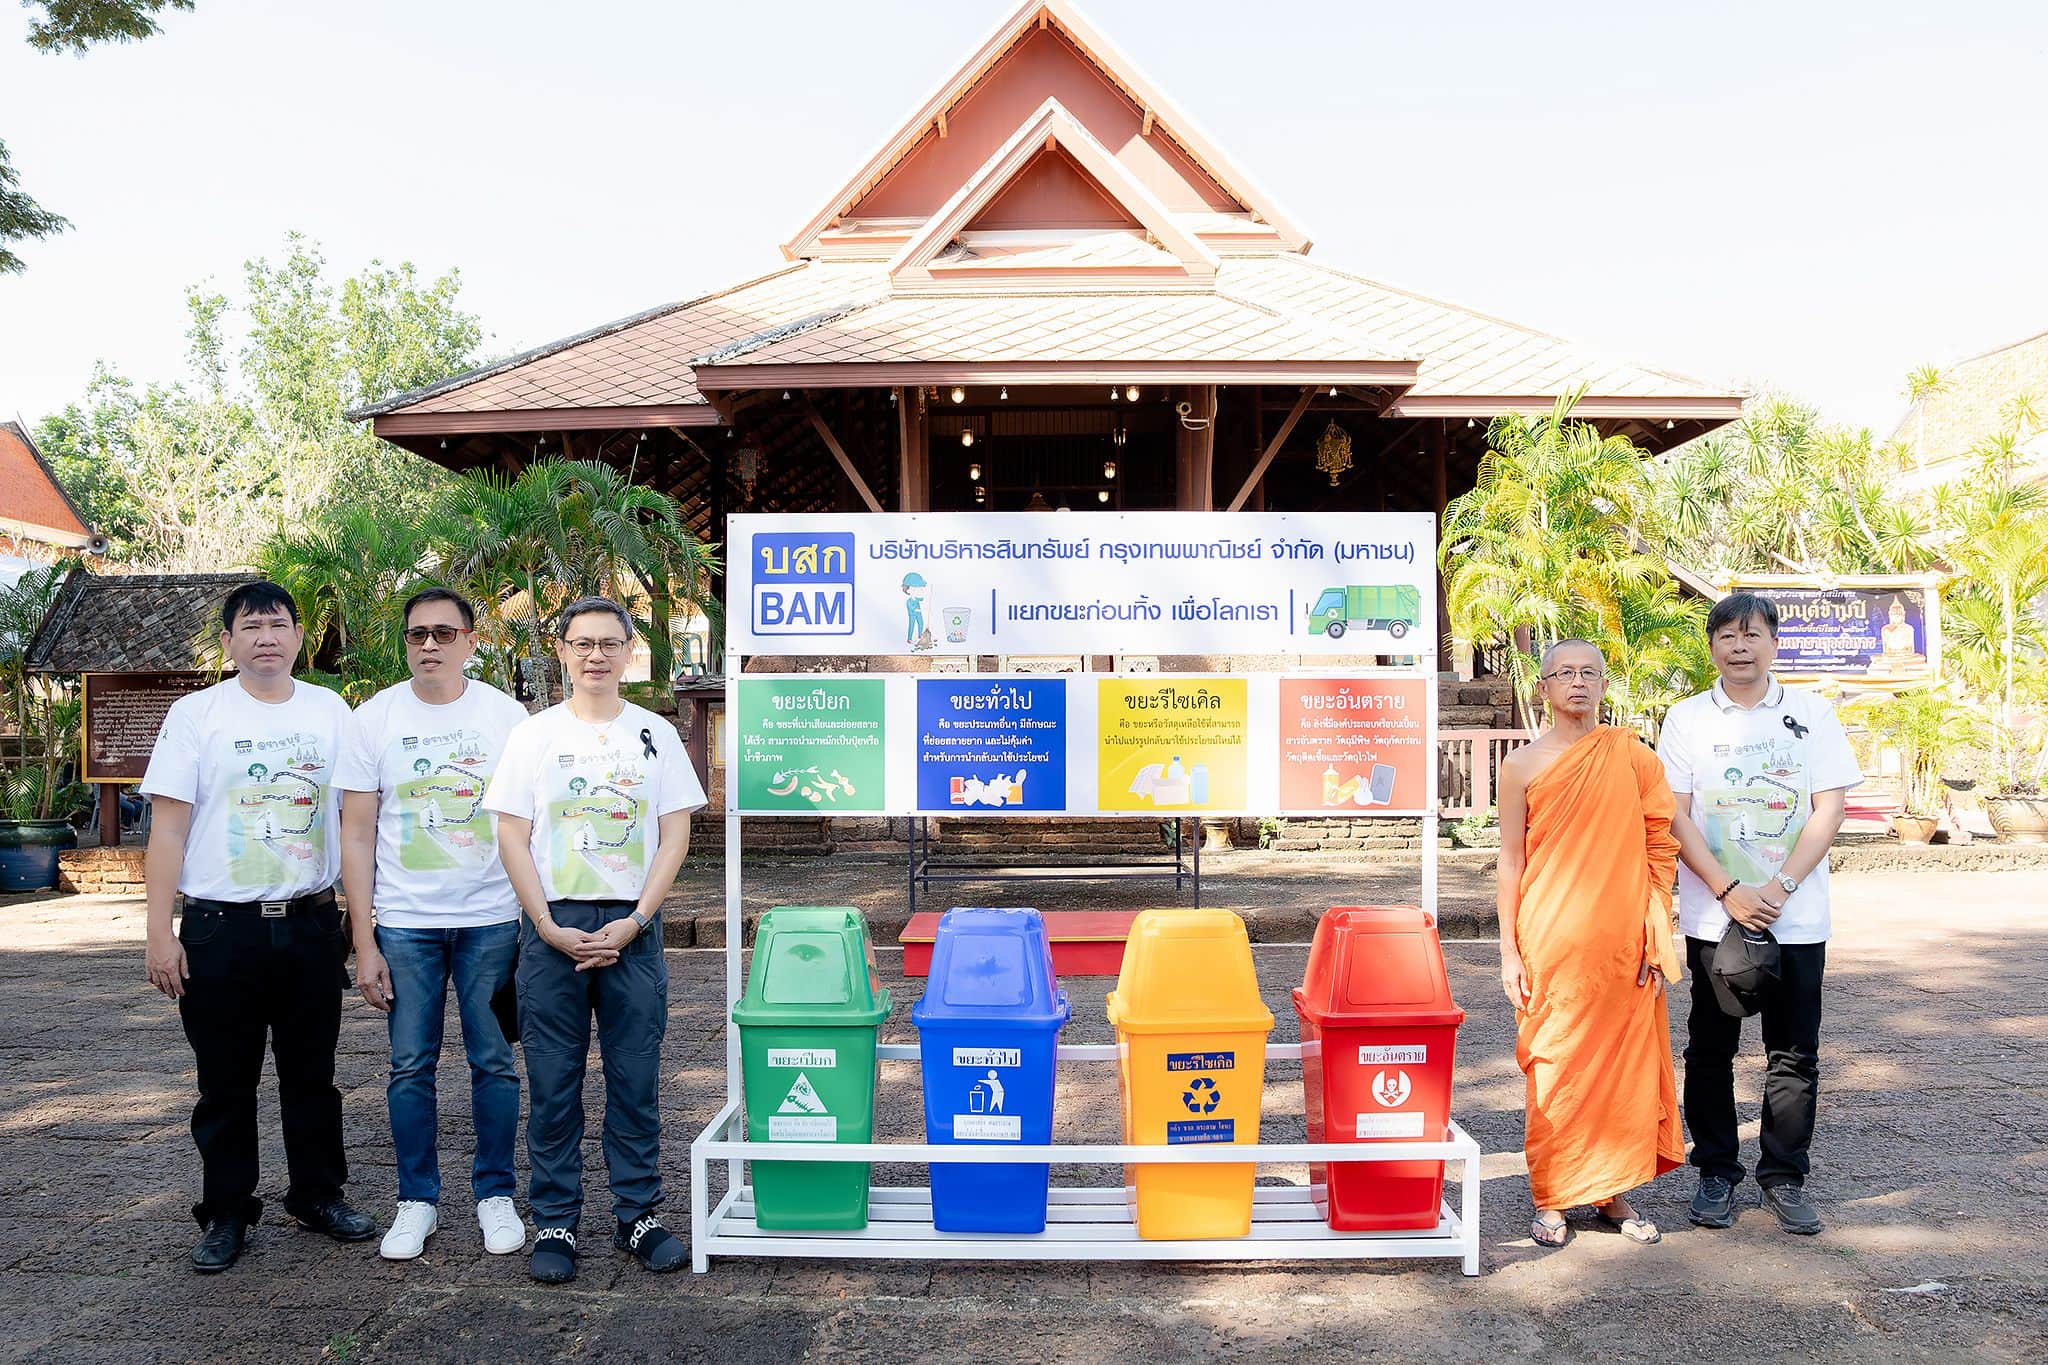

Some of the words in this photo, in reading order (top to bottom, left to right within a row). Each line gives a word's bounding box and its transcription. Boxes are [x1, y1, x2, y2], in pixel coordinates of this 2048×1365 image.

[760, 544, 847, 575] บสก
[870, 538, 1089, 560] บริษัทบริหารสินทรัพย์
[1099, 538, 1261, 564] กรุงเทพพาณิชย์
[1270, 539, 1324, 560] จำกัด
[1334, 540, 1415, 564] (มหาชน)
[761, 591, 846, 625] BAM
[1008, 595, 1161, 621] แยกขยะก่อนทิ้ง
[1171, 595, 1278, 621] เพื่อโลกเรา
[772, 687, 850, 711] ขยะเปียก
[950, 684, 1033, 711] ขยะทั่วไป
[1125, 687, 1221, 711] ขยะรีไซเคิล
[1300, 688, 1406, 711] ขยะอันตราย
[938, 717, 950, 730] คือ
[1019, 717, 1057, 730] มีลักษณะ
[922, 750, 1050, 763] สำหรับการนำกลับมาใช้ประโยชน์
[771, 1051, 832, 1066] ขยะเปียก
[956, 1049, 1018, 1066] ขยะทั่วไป
[1360, 1047, 1425, 1063] ขยะอันตราย
